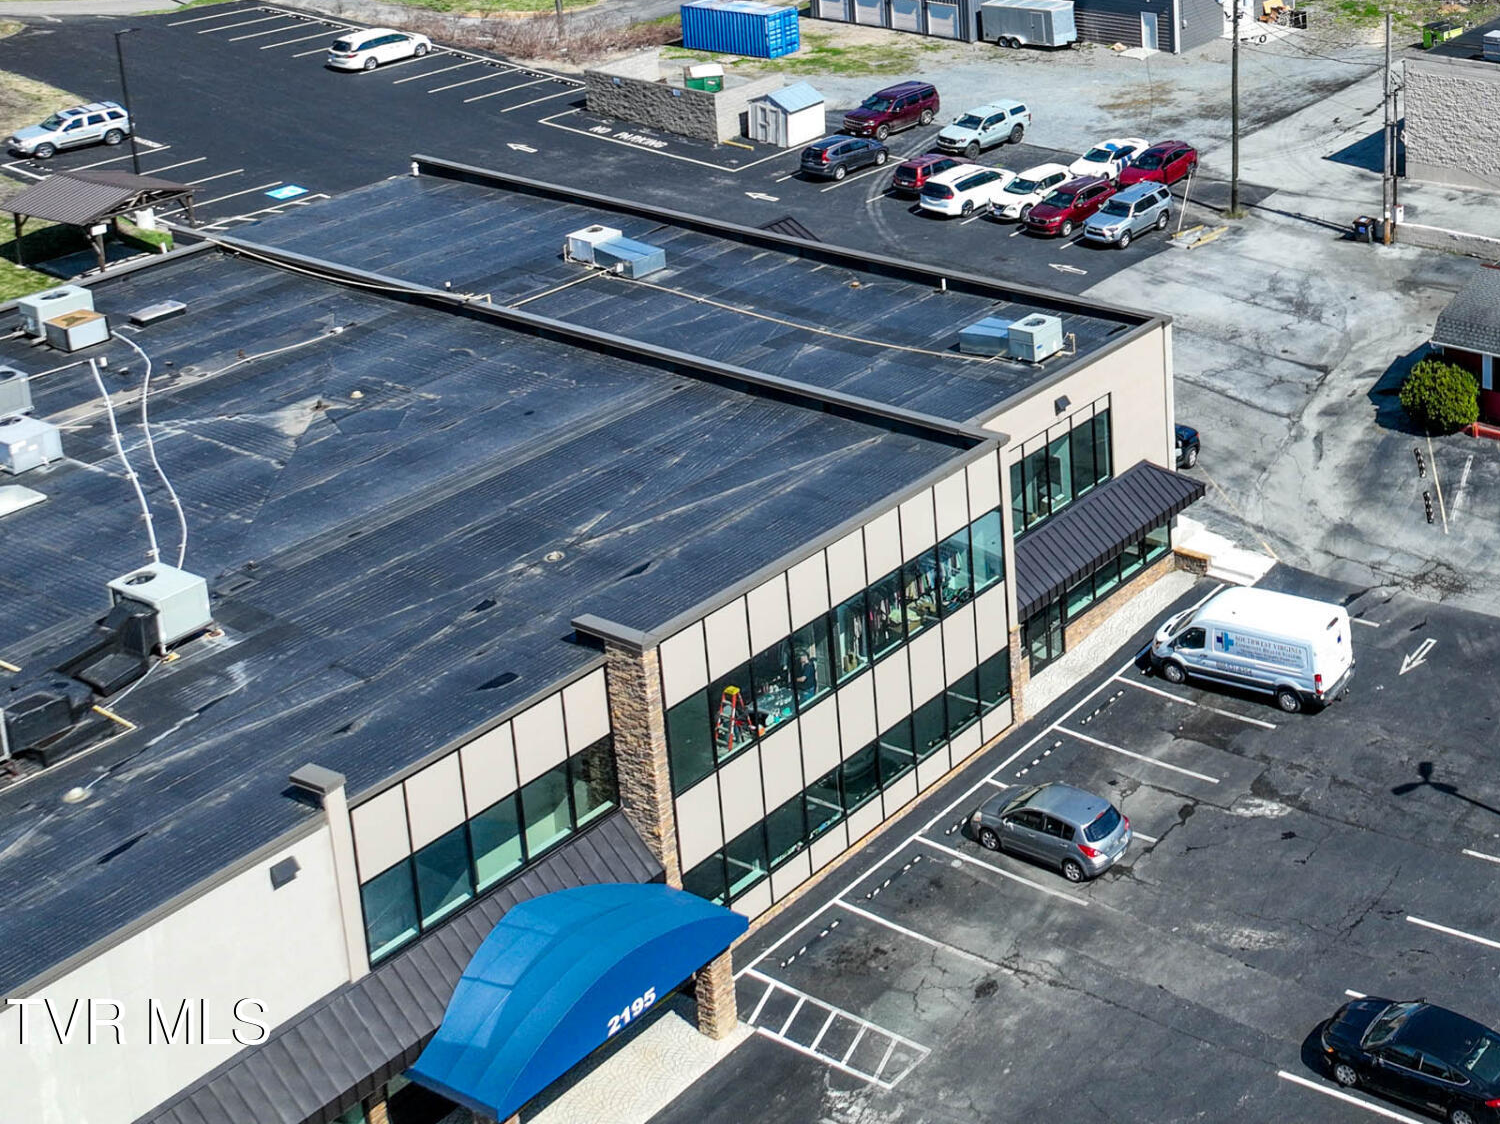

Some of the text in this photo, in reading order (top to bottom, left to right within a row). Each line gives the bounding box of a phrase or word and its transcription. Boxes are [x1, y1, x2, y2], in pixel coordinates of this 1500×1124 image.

[588, 125, 668, 149] NO PARKING
[607, 986, 657, 1038] 2195
